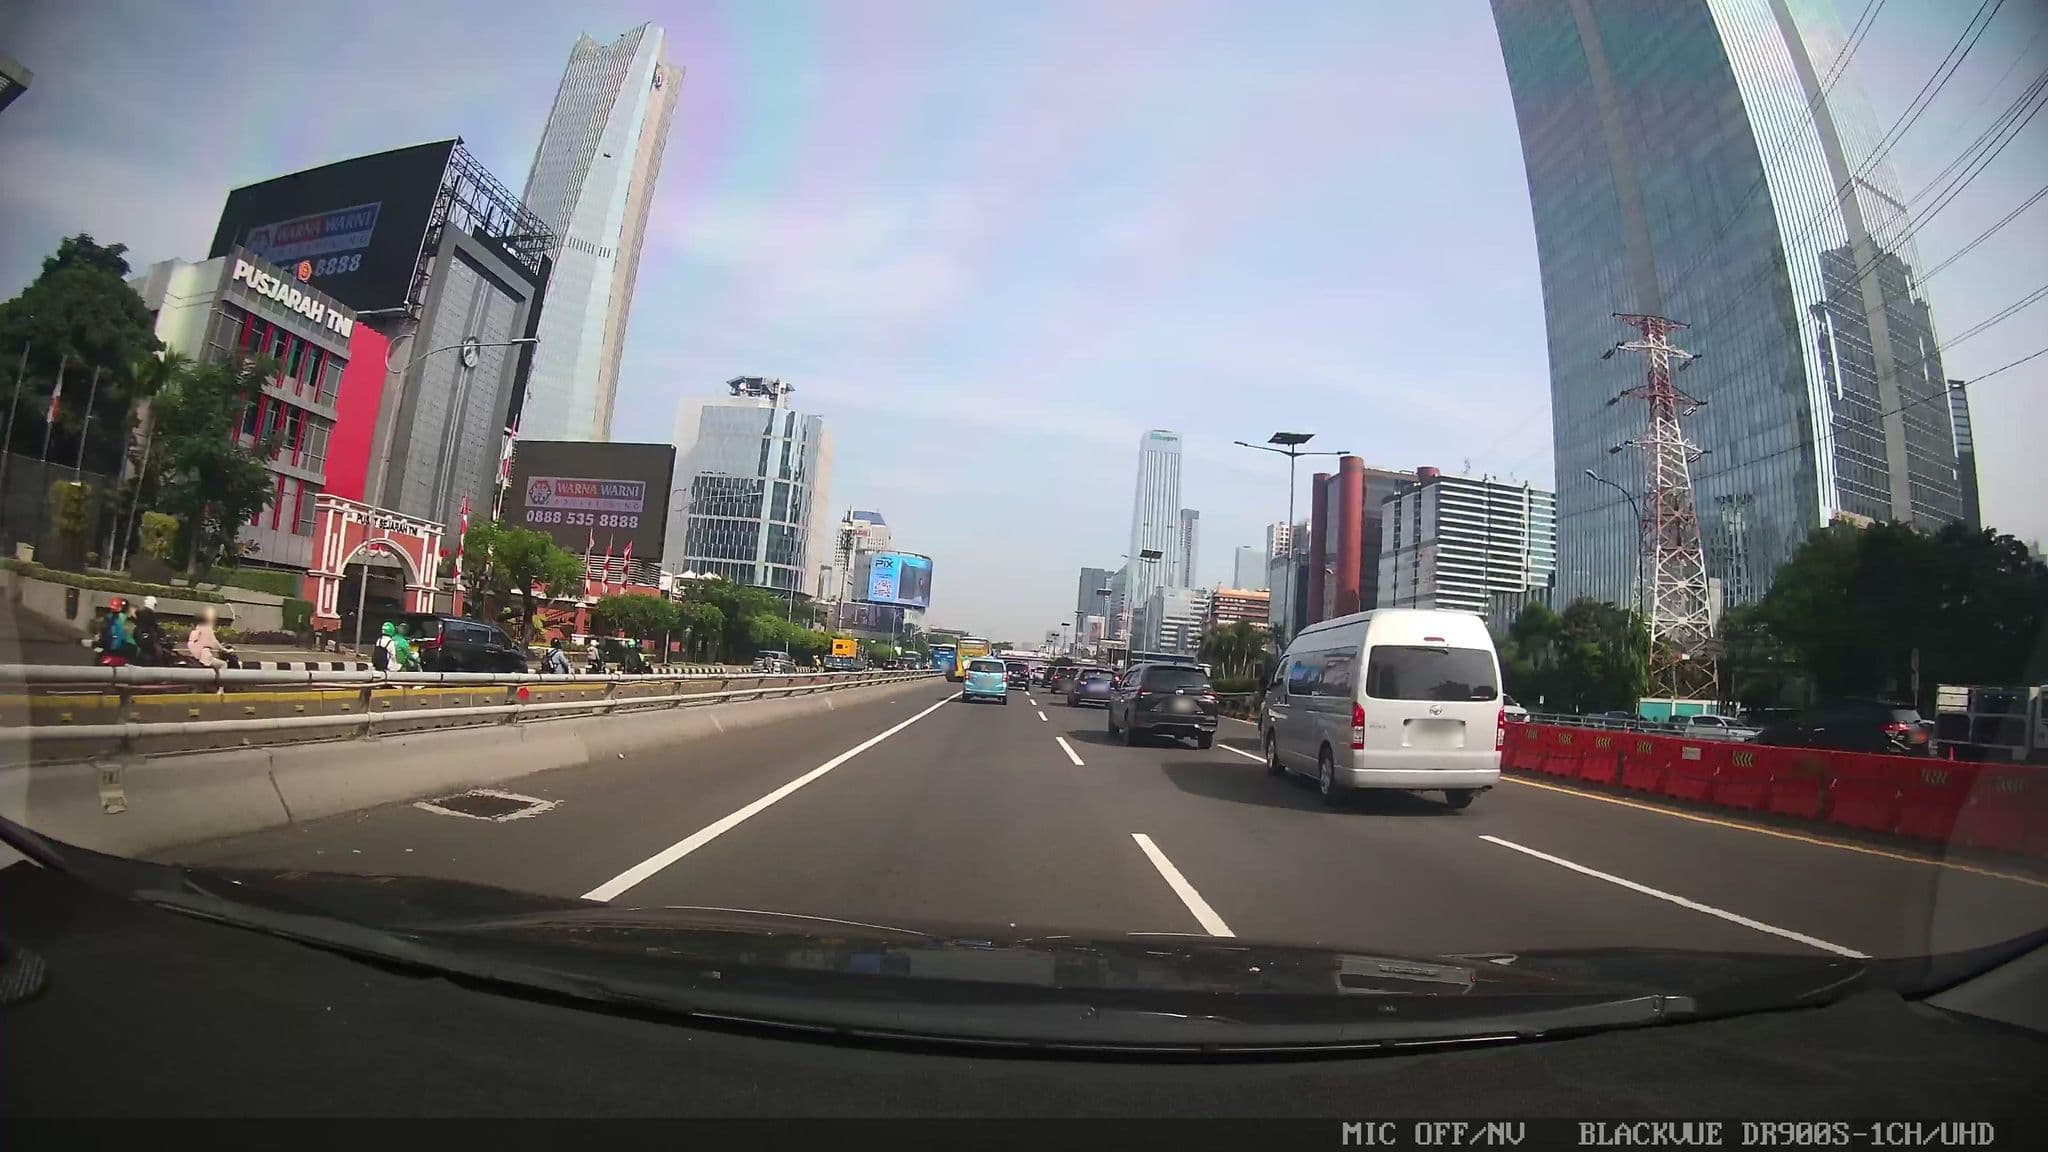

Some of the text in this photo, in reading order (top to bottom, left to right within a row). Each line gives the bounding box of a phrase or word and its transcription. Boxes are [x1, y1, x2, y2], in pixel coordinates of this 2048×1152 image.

[232, 259, 325, 324] PUSJARAH
[557, 482, 640, 497] WARNA WARNI
[526, 510, 639, 528] 0888 535 8888
